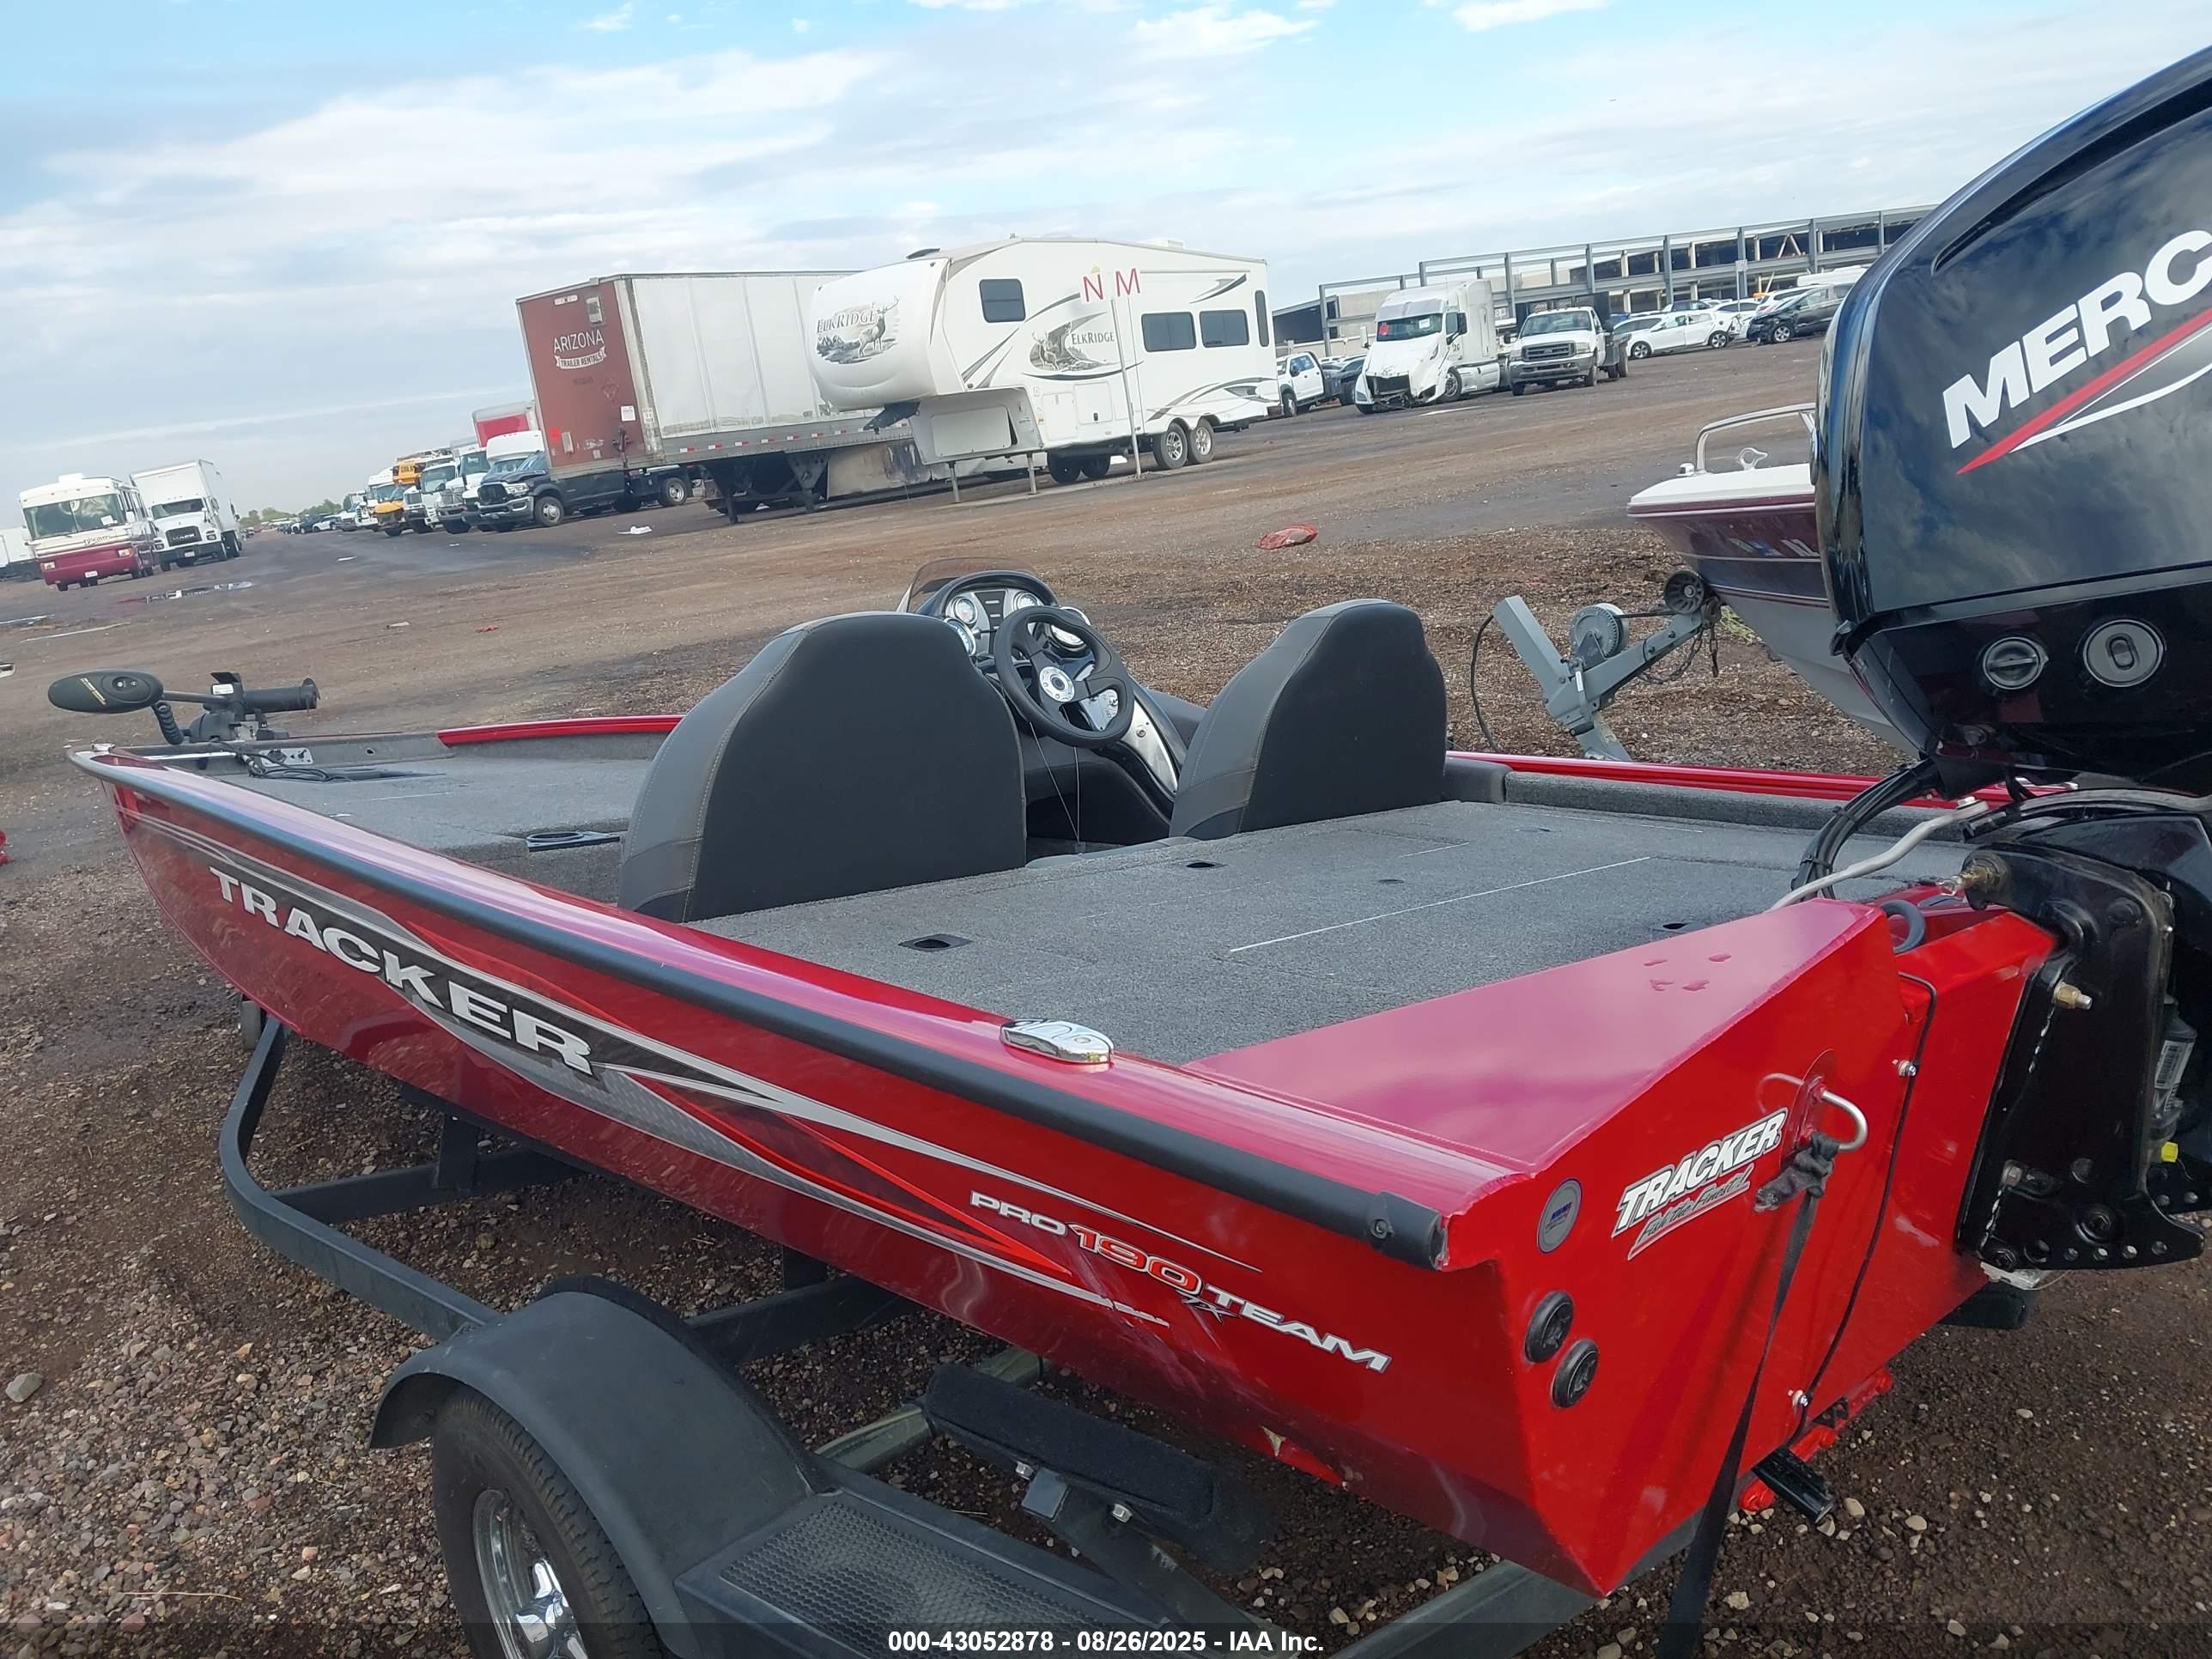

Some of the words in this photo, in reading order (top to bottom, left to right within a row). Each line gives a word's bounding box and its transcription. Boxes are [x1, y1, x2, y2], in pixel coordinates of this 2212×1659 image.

[554, 329, 605, 353] ARIZONA
[1083, 274, 1104, 302] N
[1115, 268, 1140, 297] M
[1942, 229, 2212, 449] MERC
[561, 358, 581, 368] TRAILER
[581, 351, 604, 365] RENTALS
[209, 866, 592, 1075] TRACKER
[1616, 1111, 1788, 1231] TRACKER
[970, 1191, 1066, 1237] PRO
[1068, 1223, 1204, 1297] 190
[1205, 1285, 1393, 1374] TEAM
